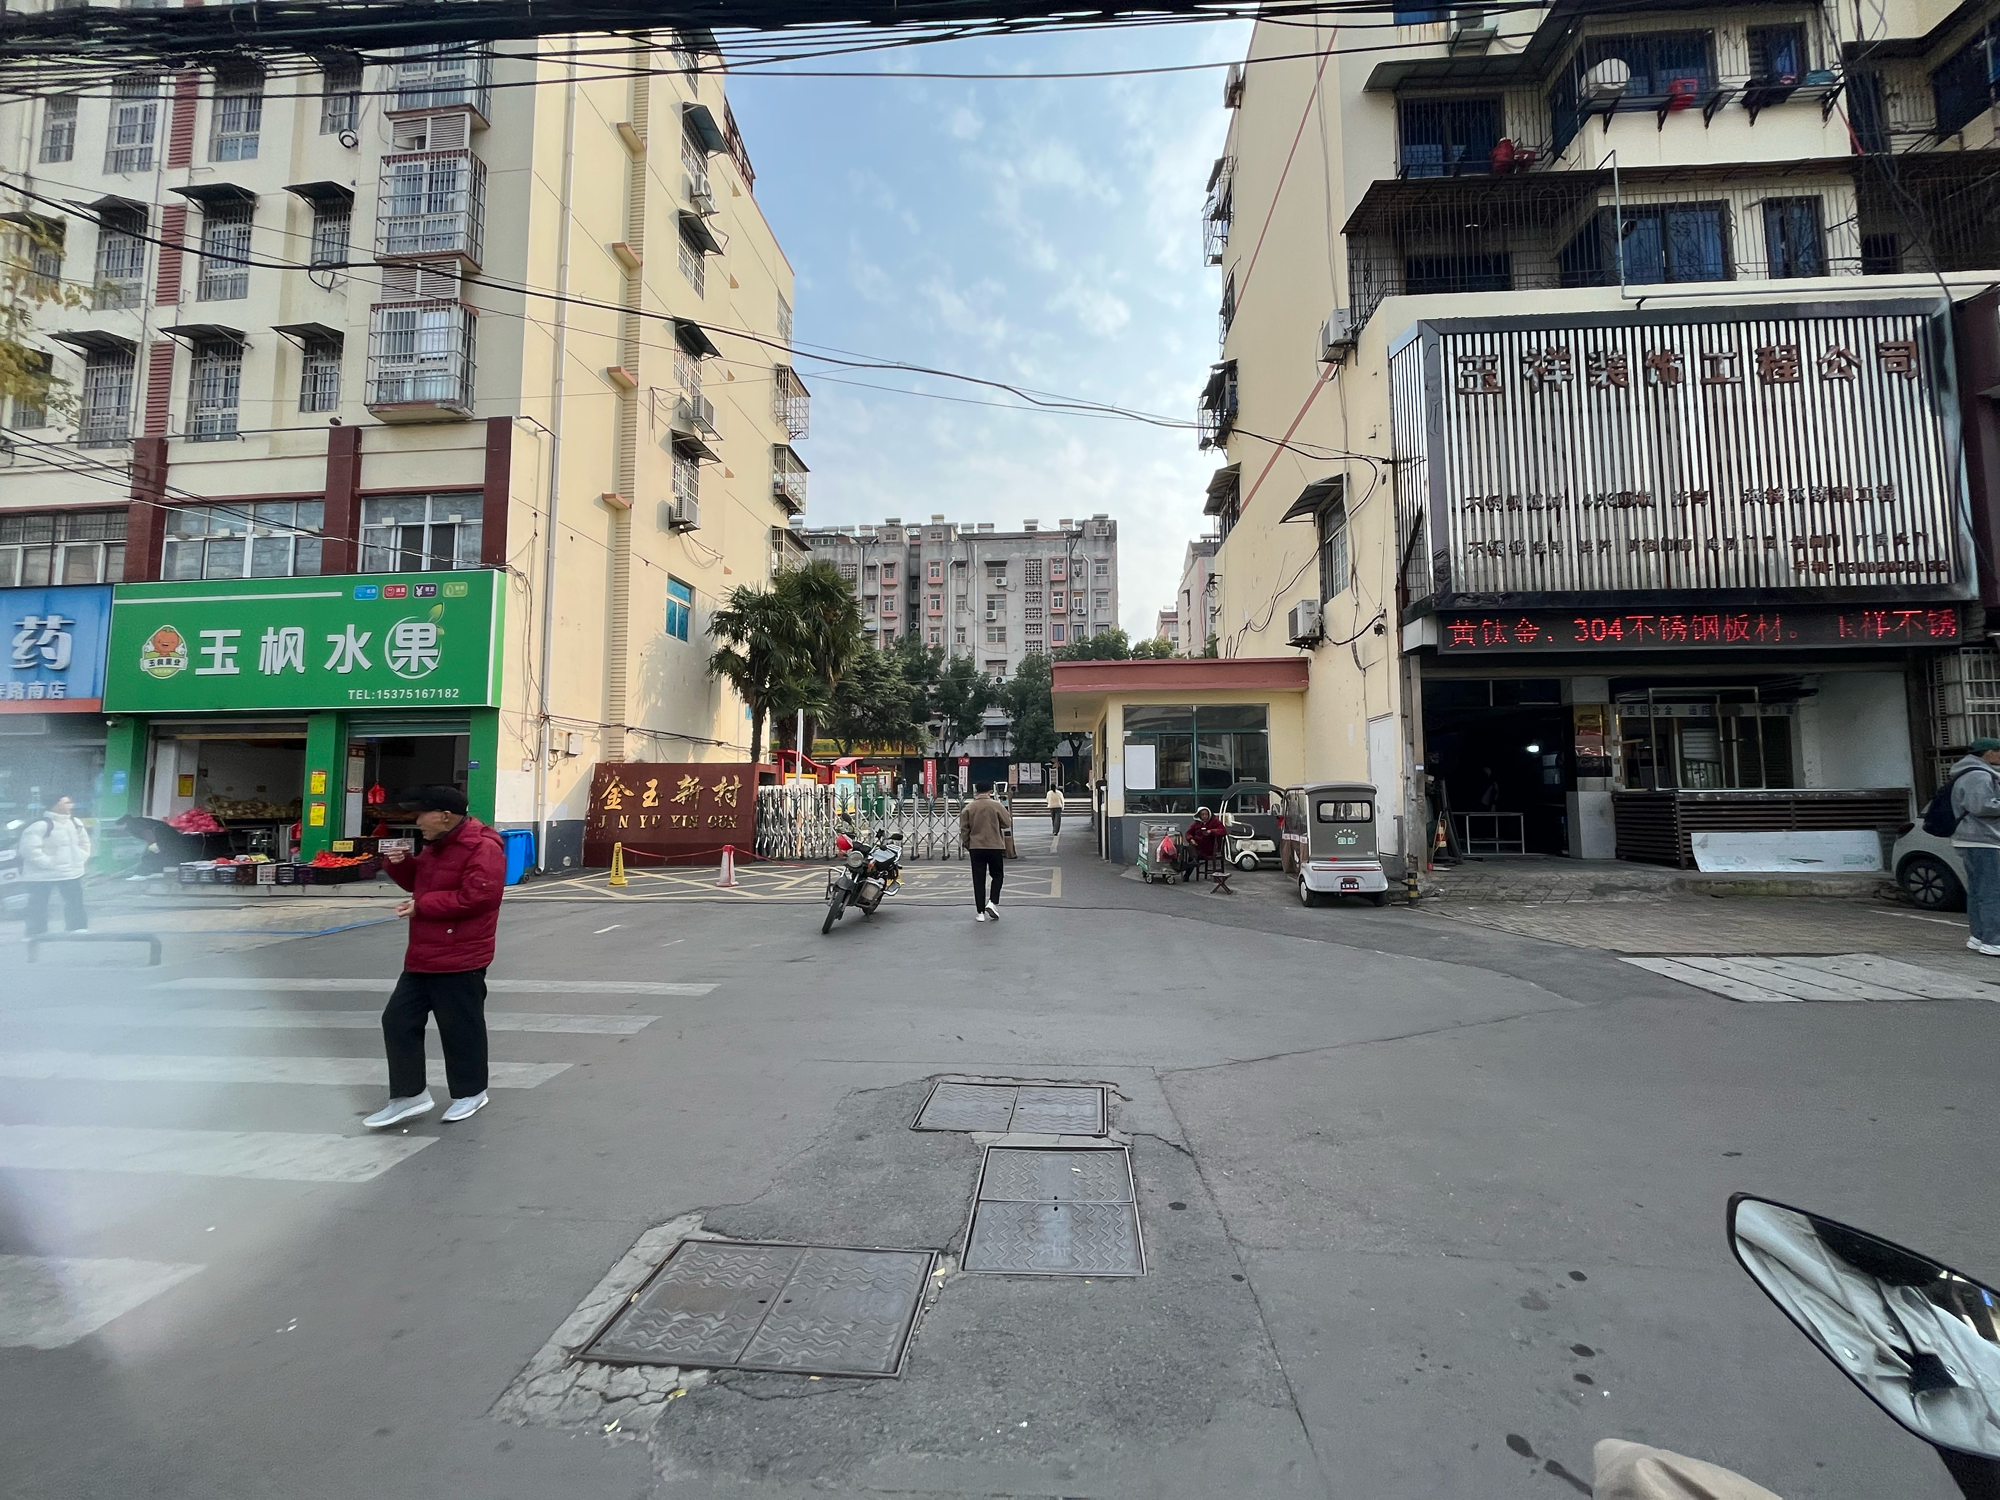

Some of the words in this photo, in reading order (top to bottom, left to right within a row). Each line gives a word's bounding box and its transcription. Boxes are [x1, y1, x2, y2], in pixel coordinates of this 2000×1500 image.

[1457, 341, 1919, 394] 玉祥装饰工程公司
[1744, 485, 1896, 506] 承接不锈钢工程
[8, 614, 77, 671] 药
[195, 622, 440, 675] 玉枫水果
[348, 688, 460, 700] TEL:15375167182
[600, 773, 743, 811] 金玉新村
